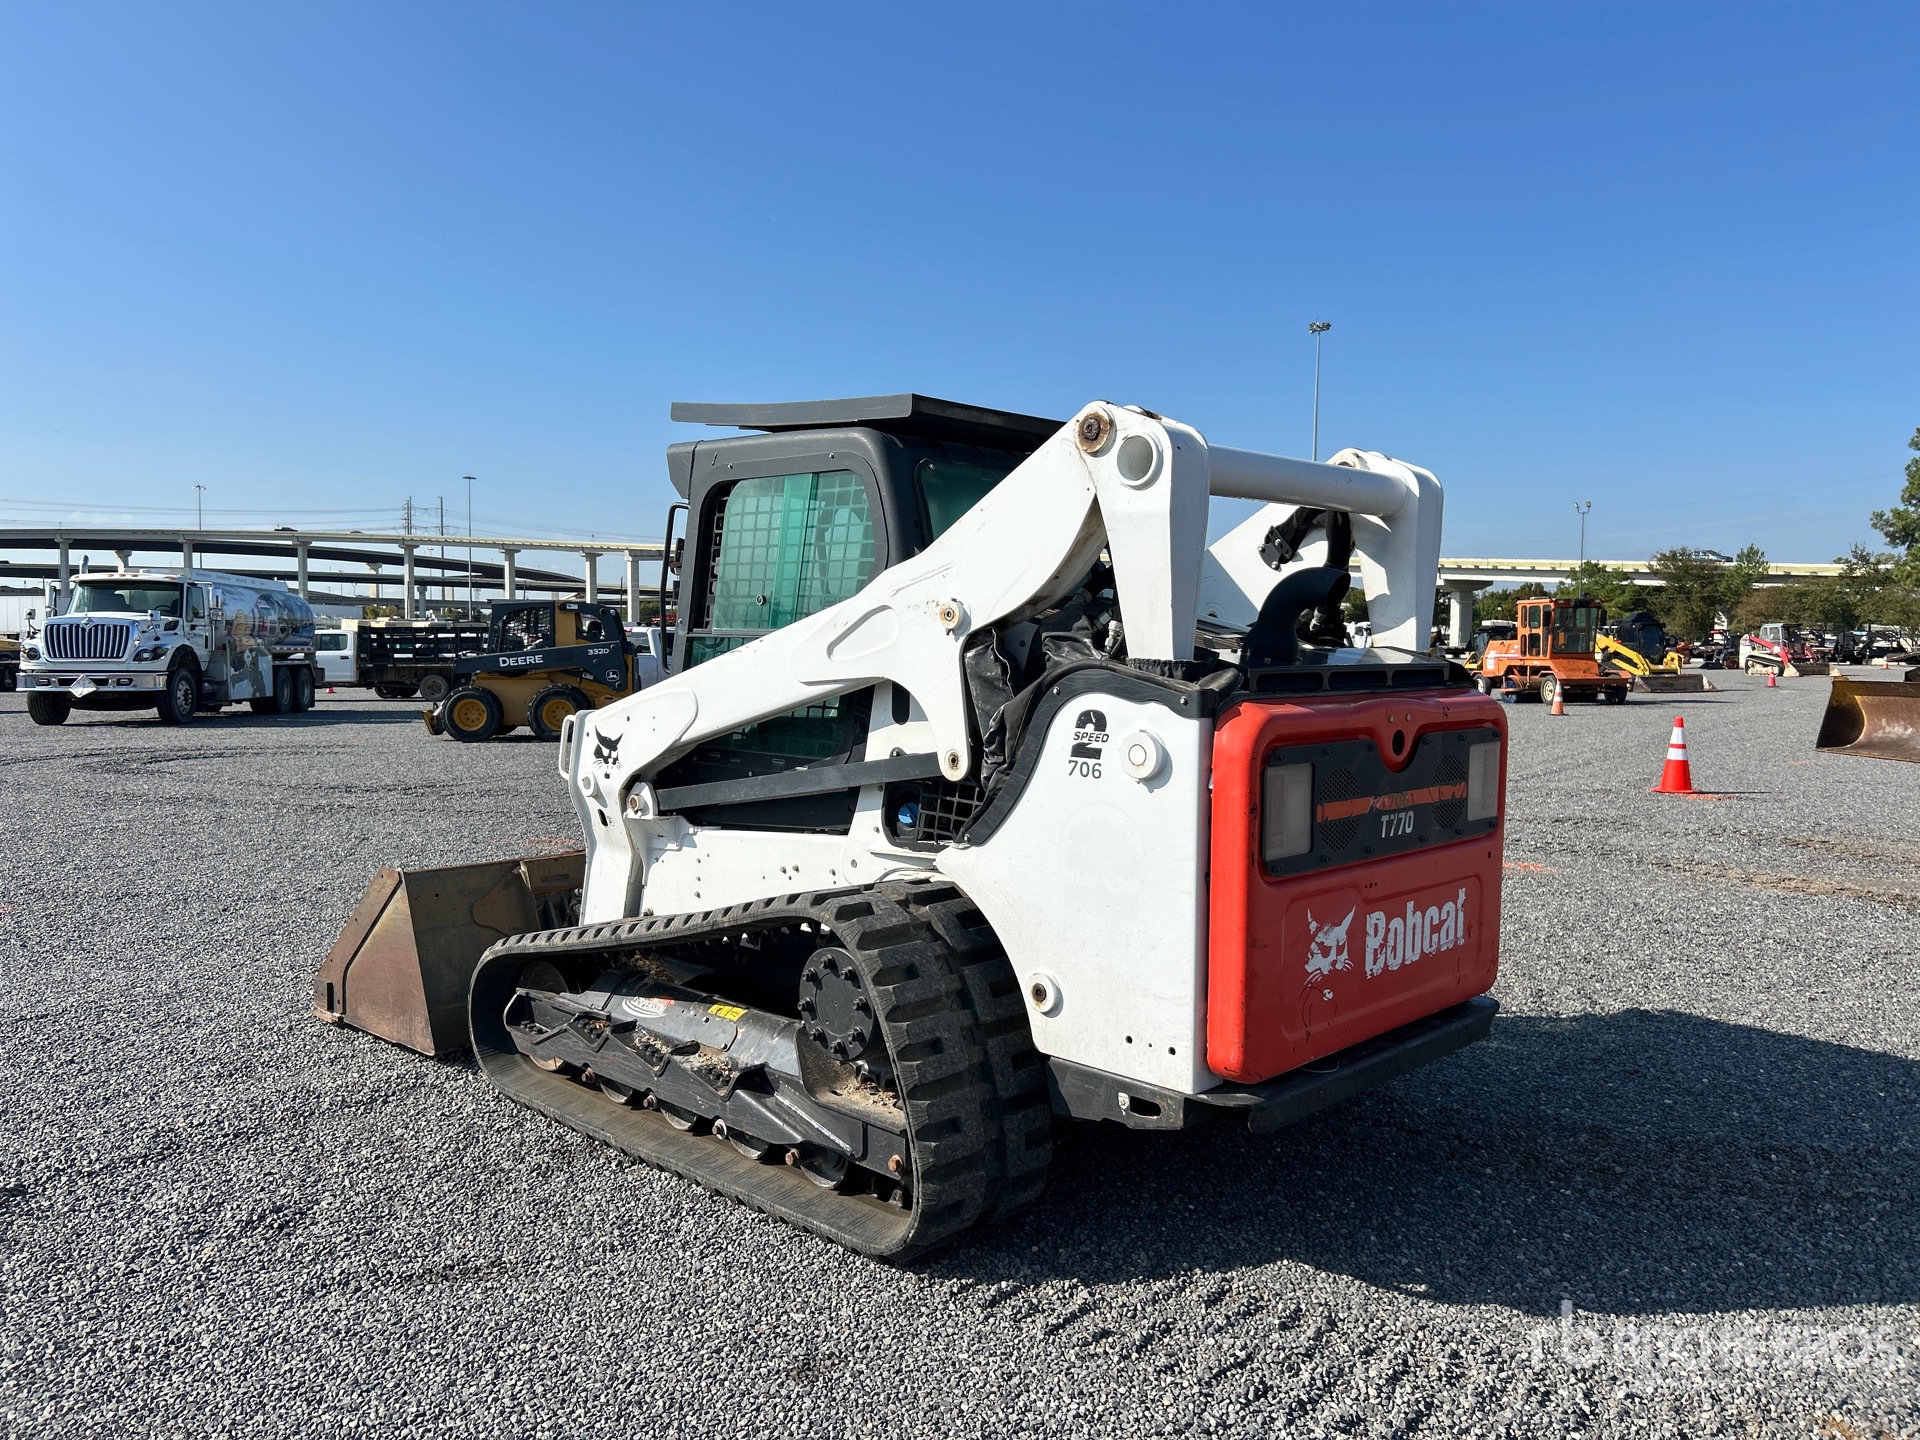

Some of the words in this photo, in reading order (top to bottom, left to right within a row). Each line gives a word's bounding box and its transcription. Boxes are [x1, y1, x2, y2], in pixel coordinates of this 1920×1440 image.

[587, 648, 609, 656] 332D
[498, 654, 544, 668] DEERE
[1073, 731, 1110, 743] SPEED
[1067, 760, 1103, 779] 706
[1380, 810, 1415, 838] T770
[1364, 887, 1467, 979] Bobcat
